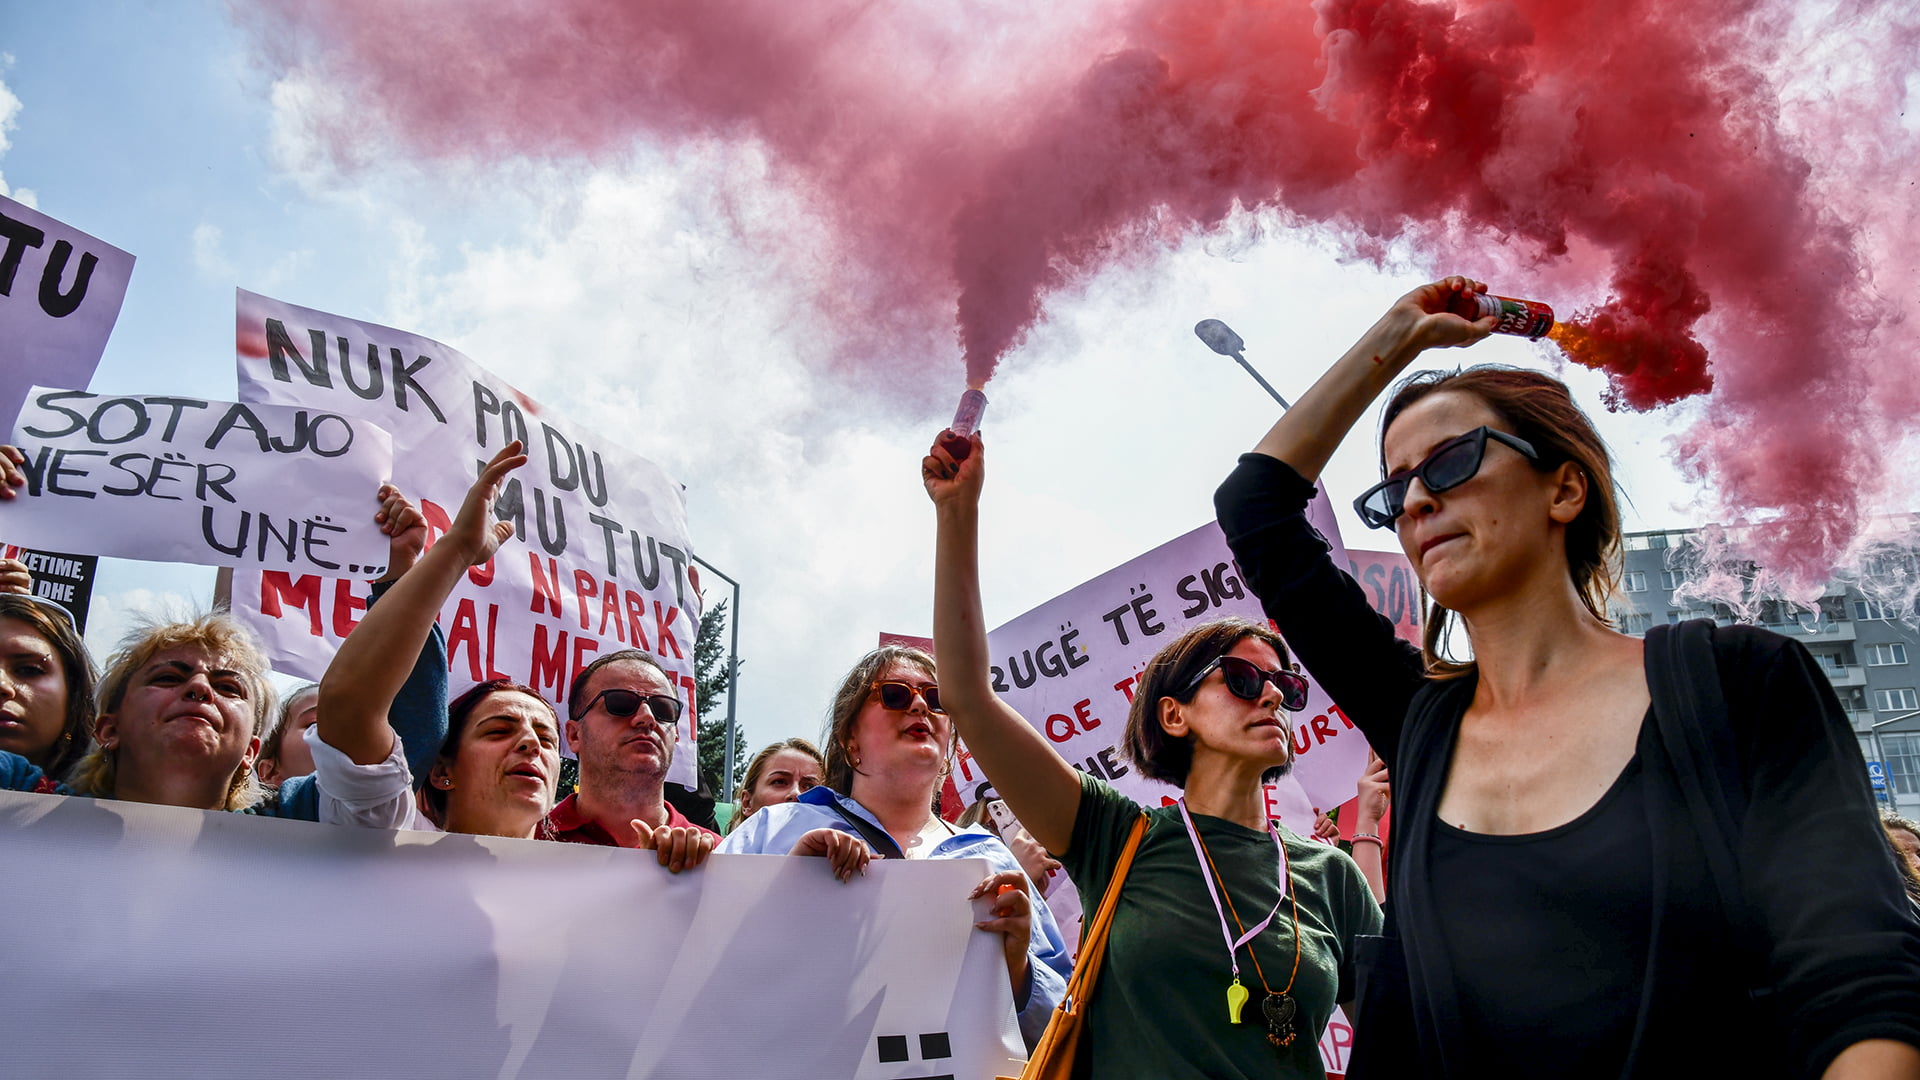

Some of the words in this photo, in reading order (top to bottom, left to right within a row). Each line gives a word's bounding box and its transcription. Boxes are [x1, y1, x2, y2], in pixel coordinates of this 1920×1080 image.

[0, 212, 99, 318] TU
[22, 390, 208, 445] SOT
[205, 402, 354, 458] AJO
[265, 317, 447, 424] NUK
[472, 380, 529, 457] PO
[541, 422, 608, 507] DU
[37, 580, 75, 603] DHE
[589, 512, 690, 610] TUT
[1102, 582, 1165, 646] TË
[1176, 559, 1249, 618] SIG
[434, 598, 511, 682] AL
[529, 552, 562, 619] N
[574, 569, 684, 660] PARK
[1045, 698, 1102, 743] QE
